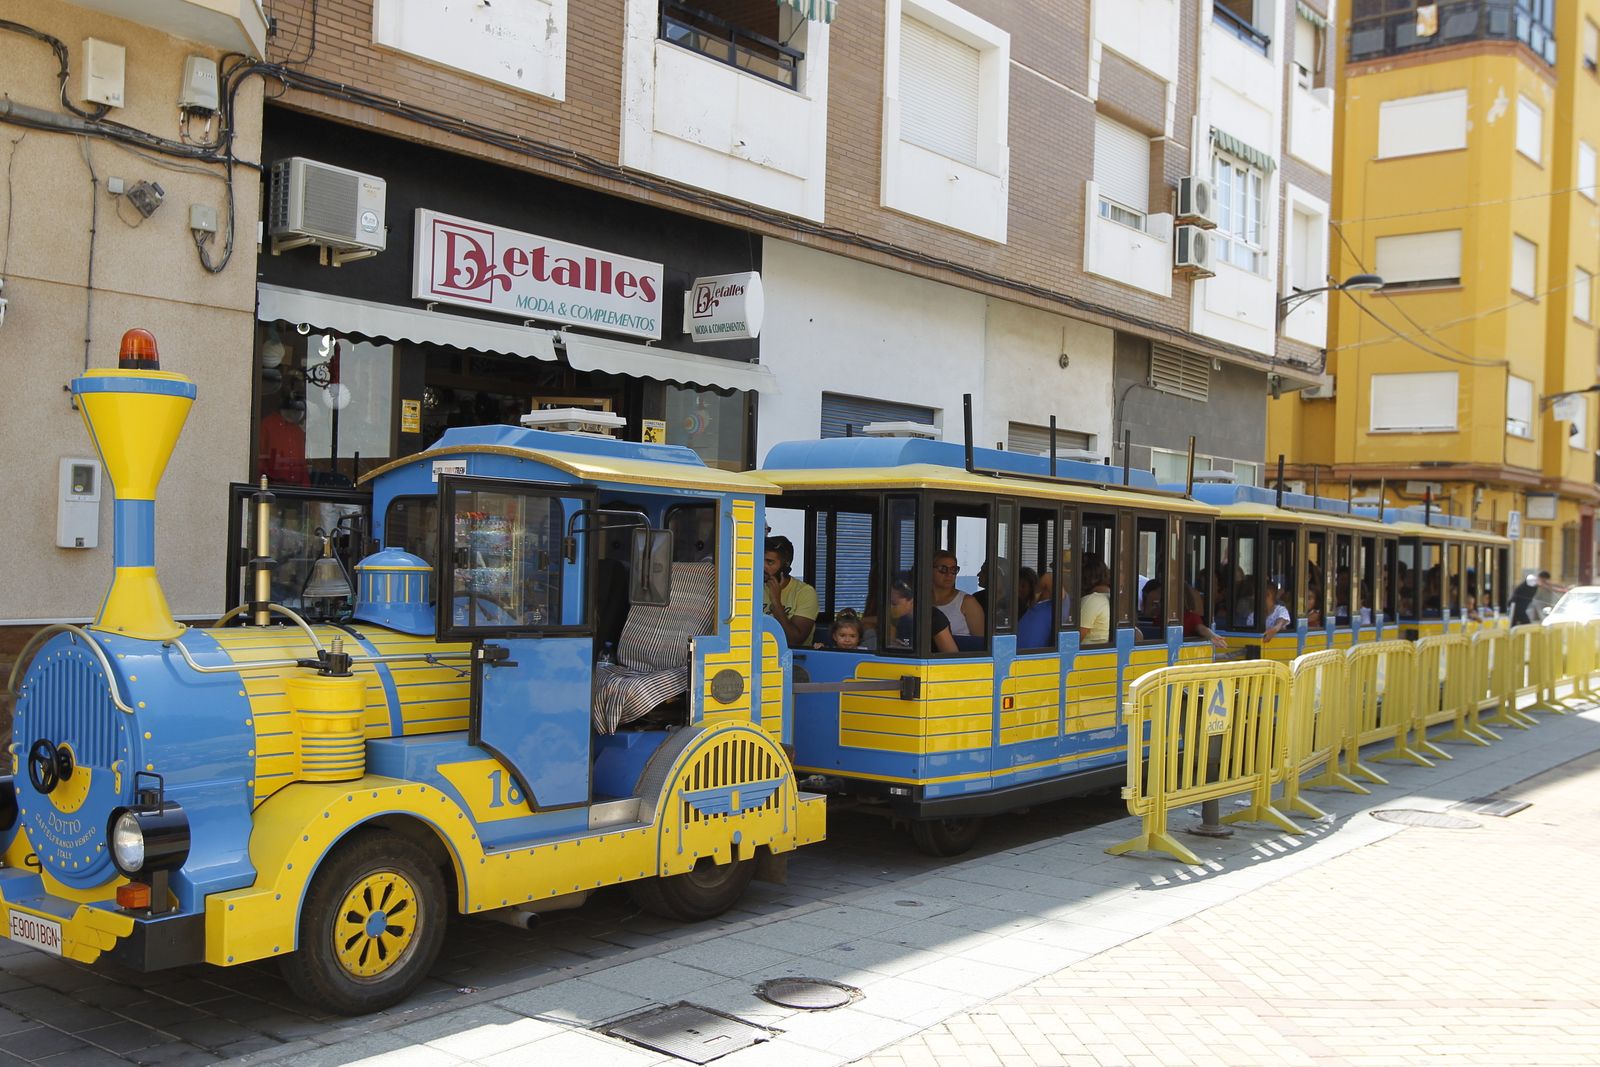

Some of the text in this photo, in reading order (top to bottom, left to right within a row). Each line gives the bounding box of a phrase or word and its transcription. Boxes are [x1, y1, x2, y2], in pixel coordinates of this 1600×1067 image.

[439, 229, 656, 303] Detalles
[515, 294, 656, 331] MODA & COMPLEMENTOS
[695, 284, 745, 314] Detalles
[695, 324, 708, 334] MODA
[712, 321, 746, 333] COMPLEMENTOS
[35, 813, 96, 849] CASTELFRANCO VENETO
[48, 812, 81, 835] DOTTO
[57, 848, 72, 860] ITALY
[13, 916, 58, 948] E9001BGN
